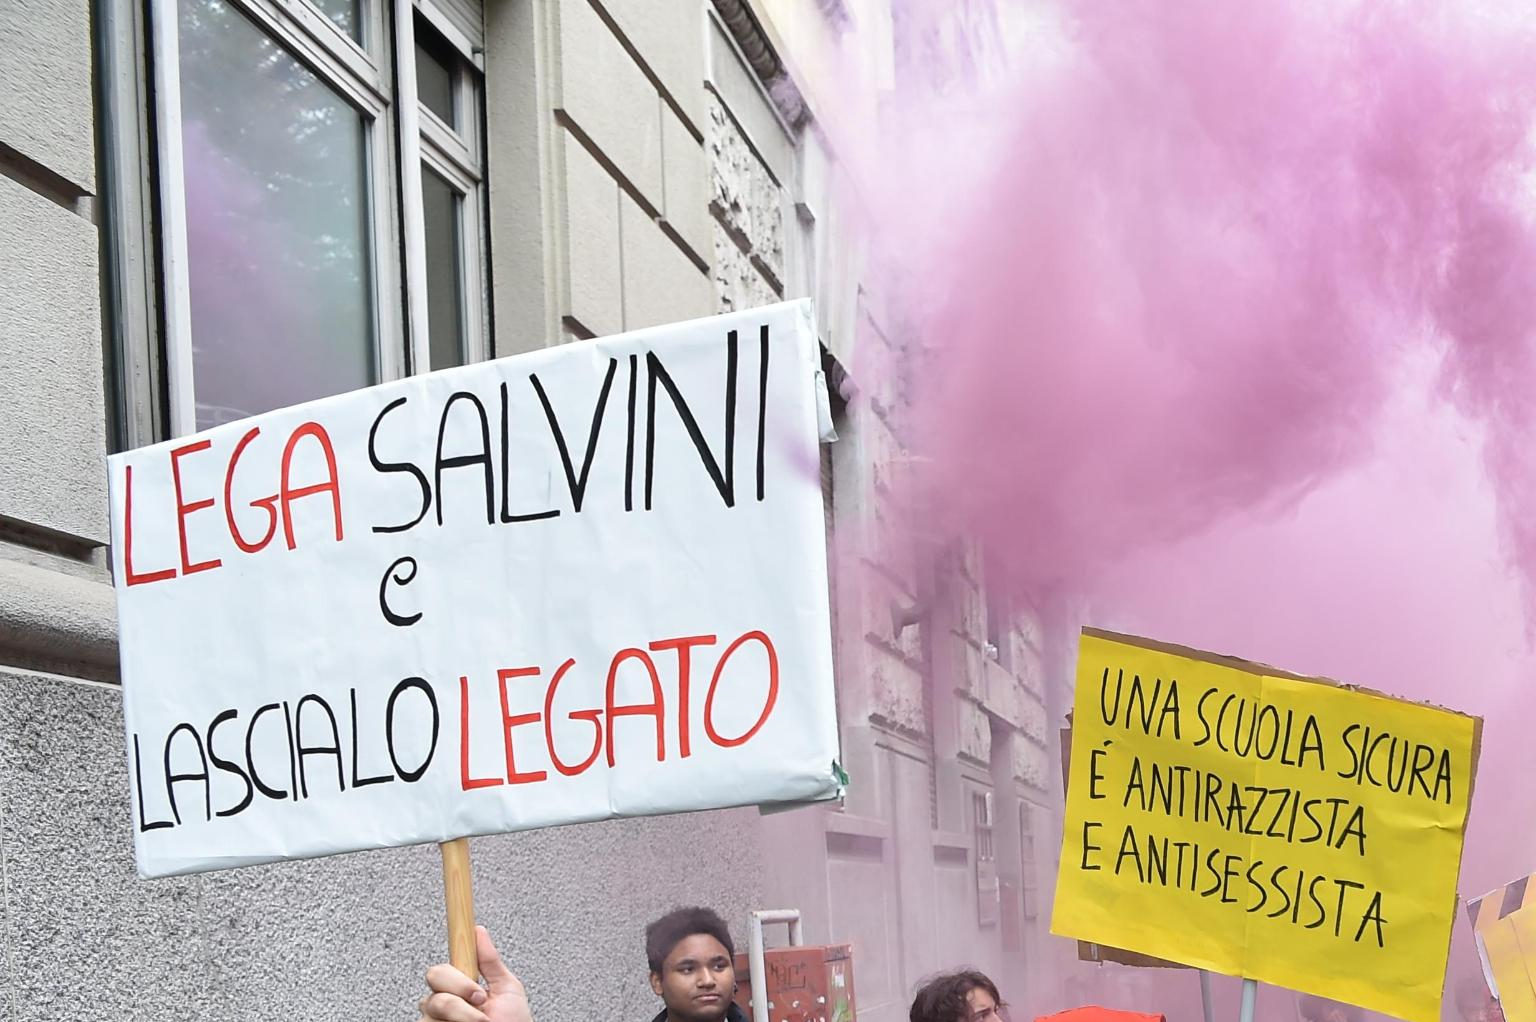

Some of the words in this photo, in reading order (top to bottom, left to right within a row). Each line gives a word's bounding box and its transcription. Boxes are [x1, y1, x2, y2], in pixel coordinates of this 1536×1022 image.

[125, 421, 344, 587] LEGA
[367, 324, 770, 534] SALVINI
[133, 676, 441, 833] LASCIALO
[459, 629, 780, 792] LEGATO
[1100, 667, 1182, 741] UNA
[1193, 687, 1326, 771] SCUOLA
[1336, 724, 1453, 804] SICURA
[1123, 756, 1368, 857] ANTIRAZZISTA
[1080, 821, 1102, 871] E
[1114, 825, 1389, 948] ANTISESSISTA
